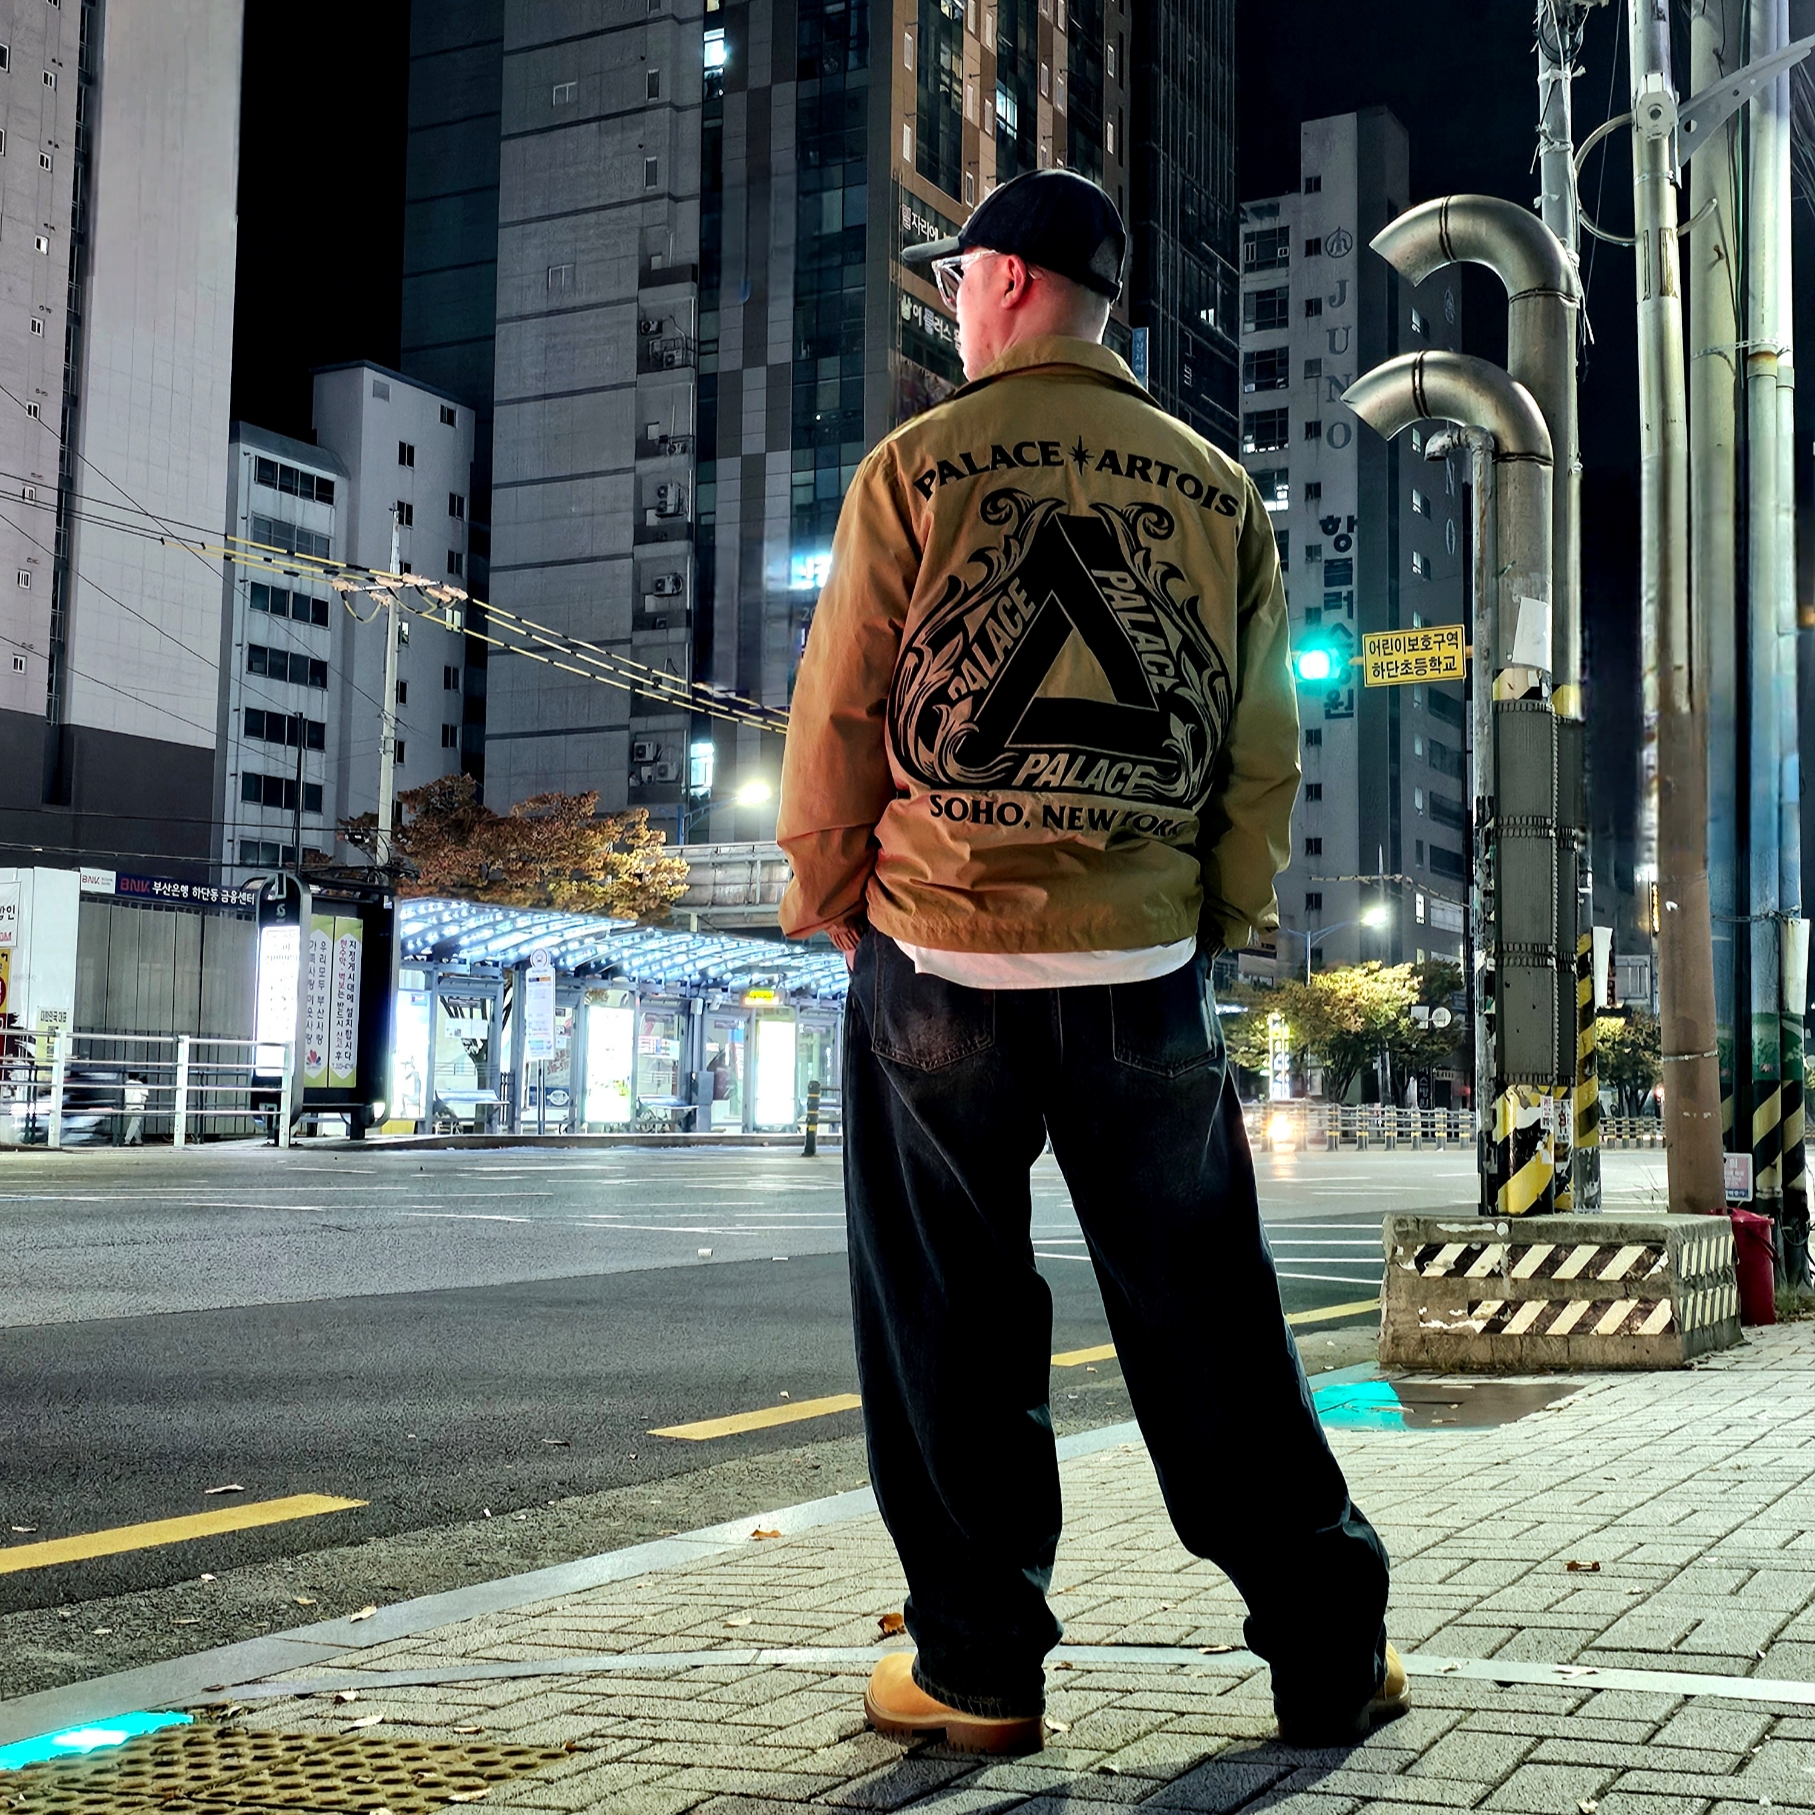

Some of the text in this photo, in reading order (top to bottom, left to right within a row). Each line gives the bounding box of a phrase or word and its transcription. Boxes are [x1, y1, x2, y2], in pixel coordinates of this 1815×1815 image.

[1326, 280, 1352, 449] JUNO
[913, 441, 1239, 518] PALACE ARTOIS
[947, 577, 1036, 701] PALACE
[1091, 569, 1180, 693] PALACE
[1369, 631, 1459, 658] 어린이보호구역
[1371, 656, 1457, 679] 하단초등학교
[1011, 753, 1156, 798] PALACE
[930, 794, 1031, 829] SOHO,
[1042, 804, 1119, 831] NEW
[120, 877, 150, 893] BNK
[152, 881, 189, 899] 부산은행
[192, 885, 219, 901] 하단동
[221, 890, 256, 906] 금융센터
